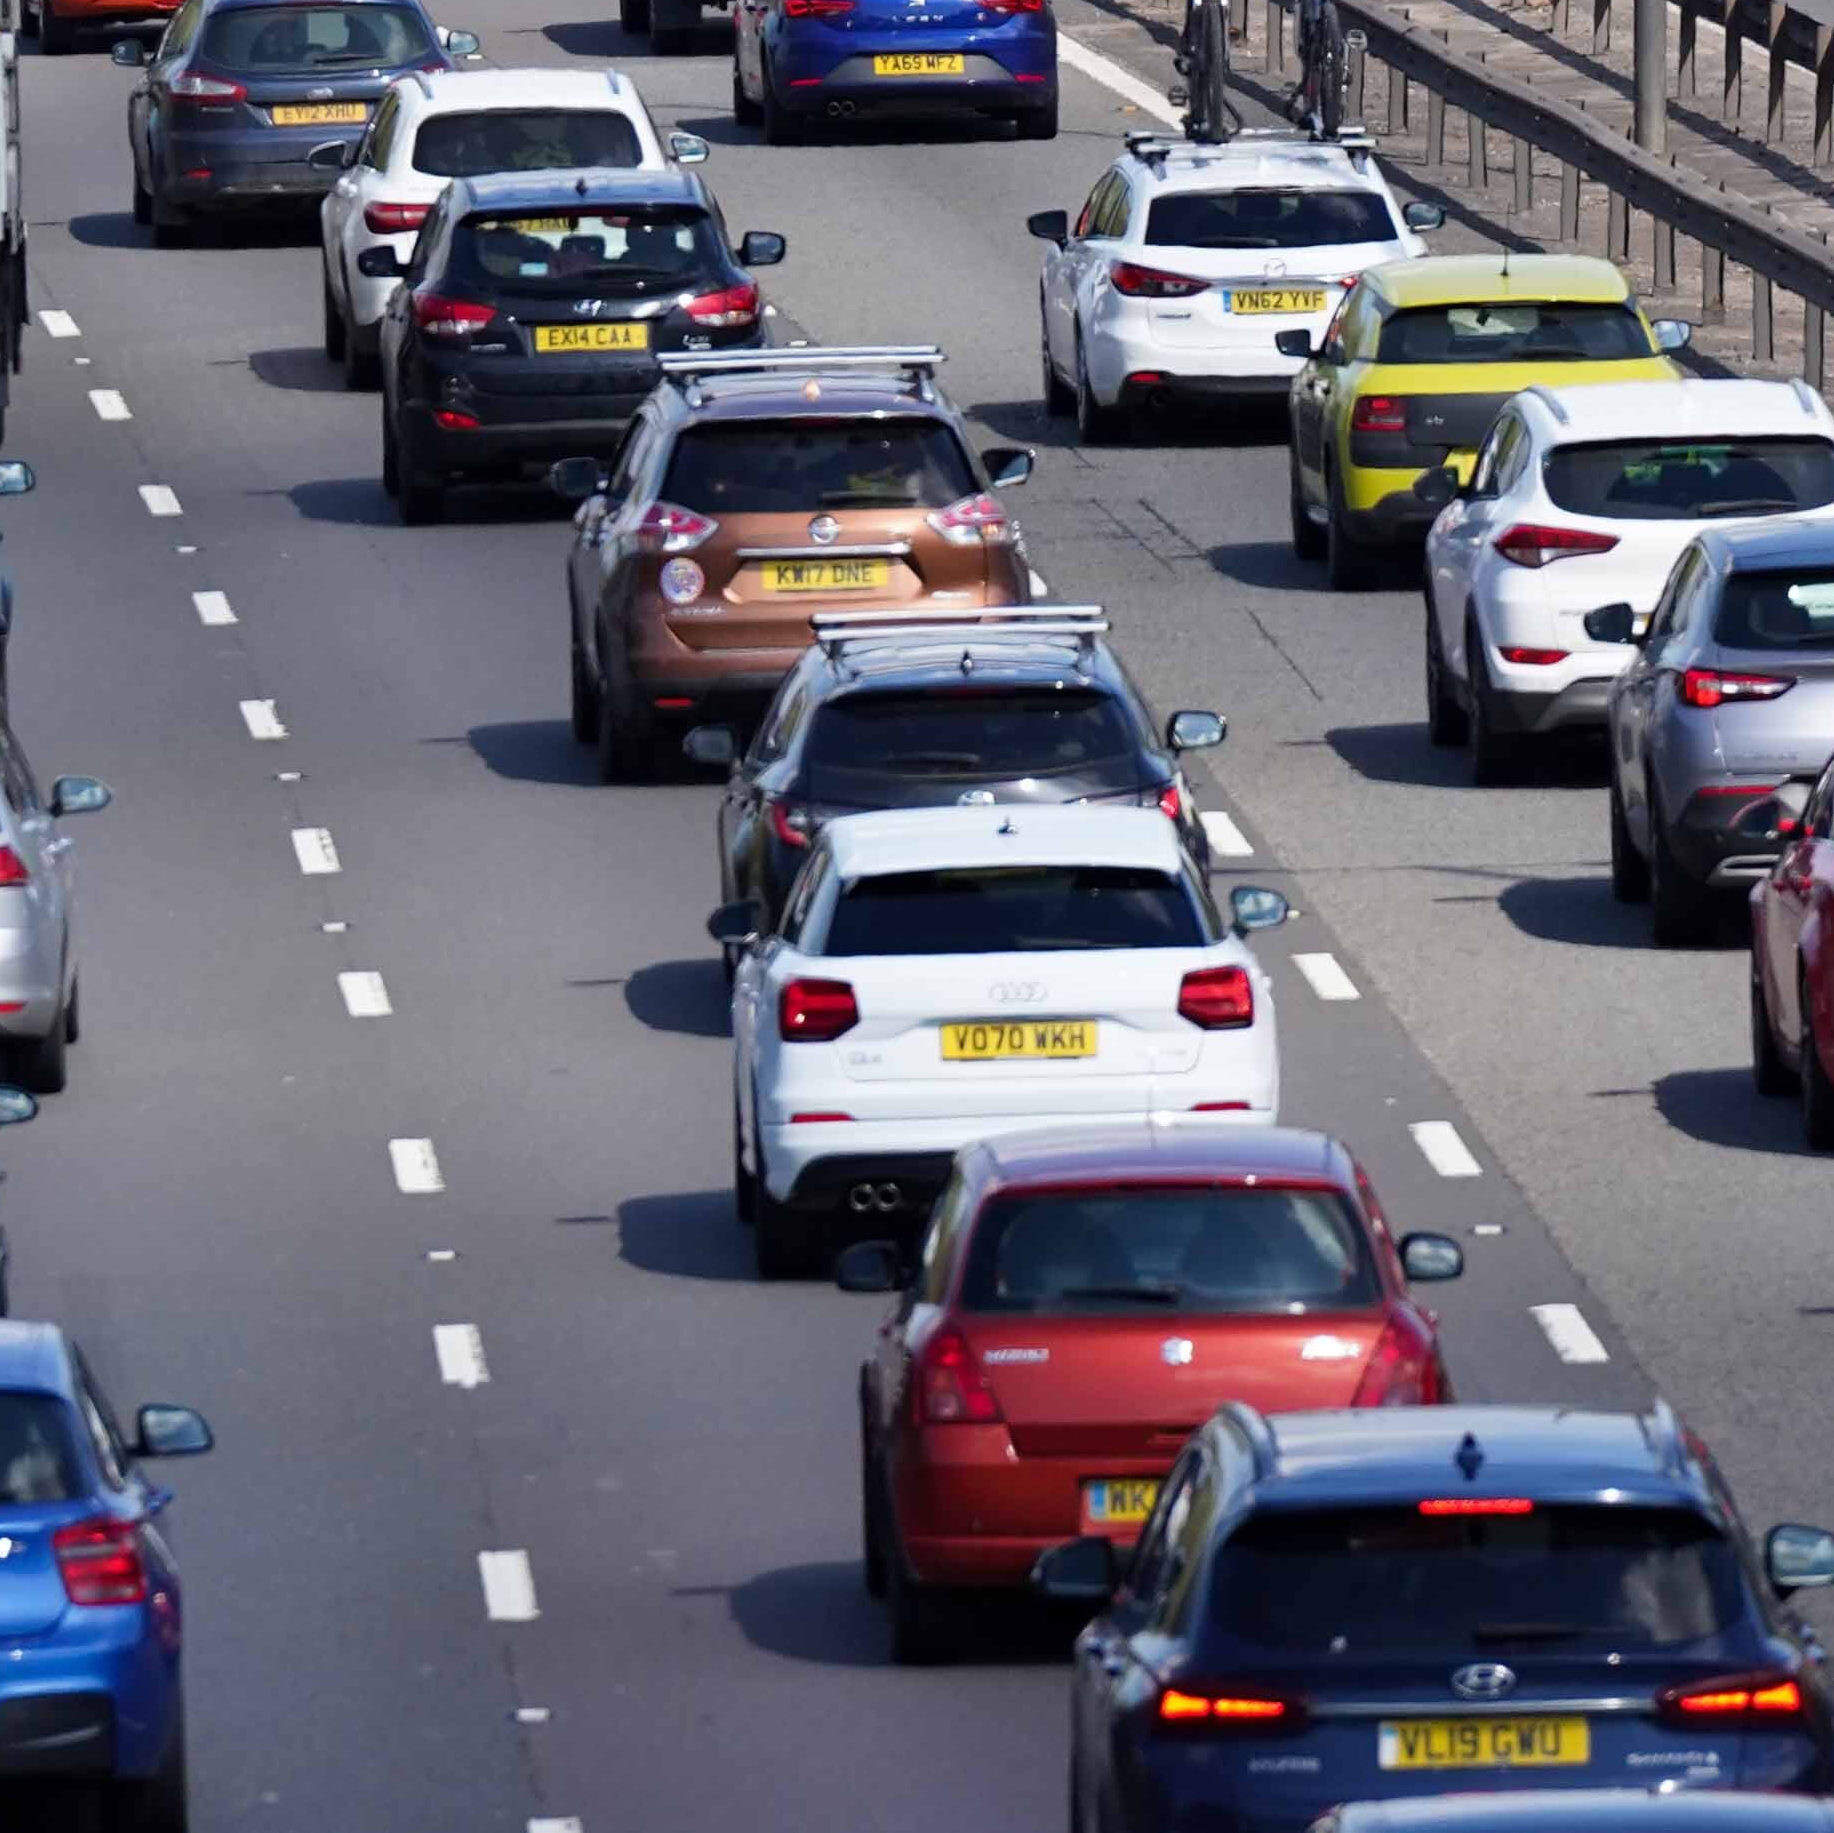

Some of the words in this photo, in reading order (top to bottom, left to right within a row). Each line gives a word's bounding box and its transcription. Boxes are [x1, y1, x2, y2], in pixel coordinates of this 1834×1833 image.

[882, 55, 921, 70] YA69
[927, 54, 957, 70] WFZ
[1237, 291, 1284, 309] VN62
[548, 327, 589, 346] EX14
[595, 326, 632, 344] CAA
[776, 564, 823, 585] KW17
[832, 562, 872, 584] DNE
[1035, 1026, 1086, 1048] WKH
[1400, 1728, 1478, 1760] VL19
[1490, 1724, 1562, 1758] GWU
